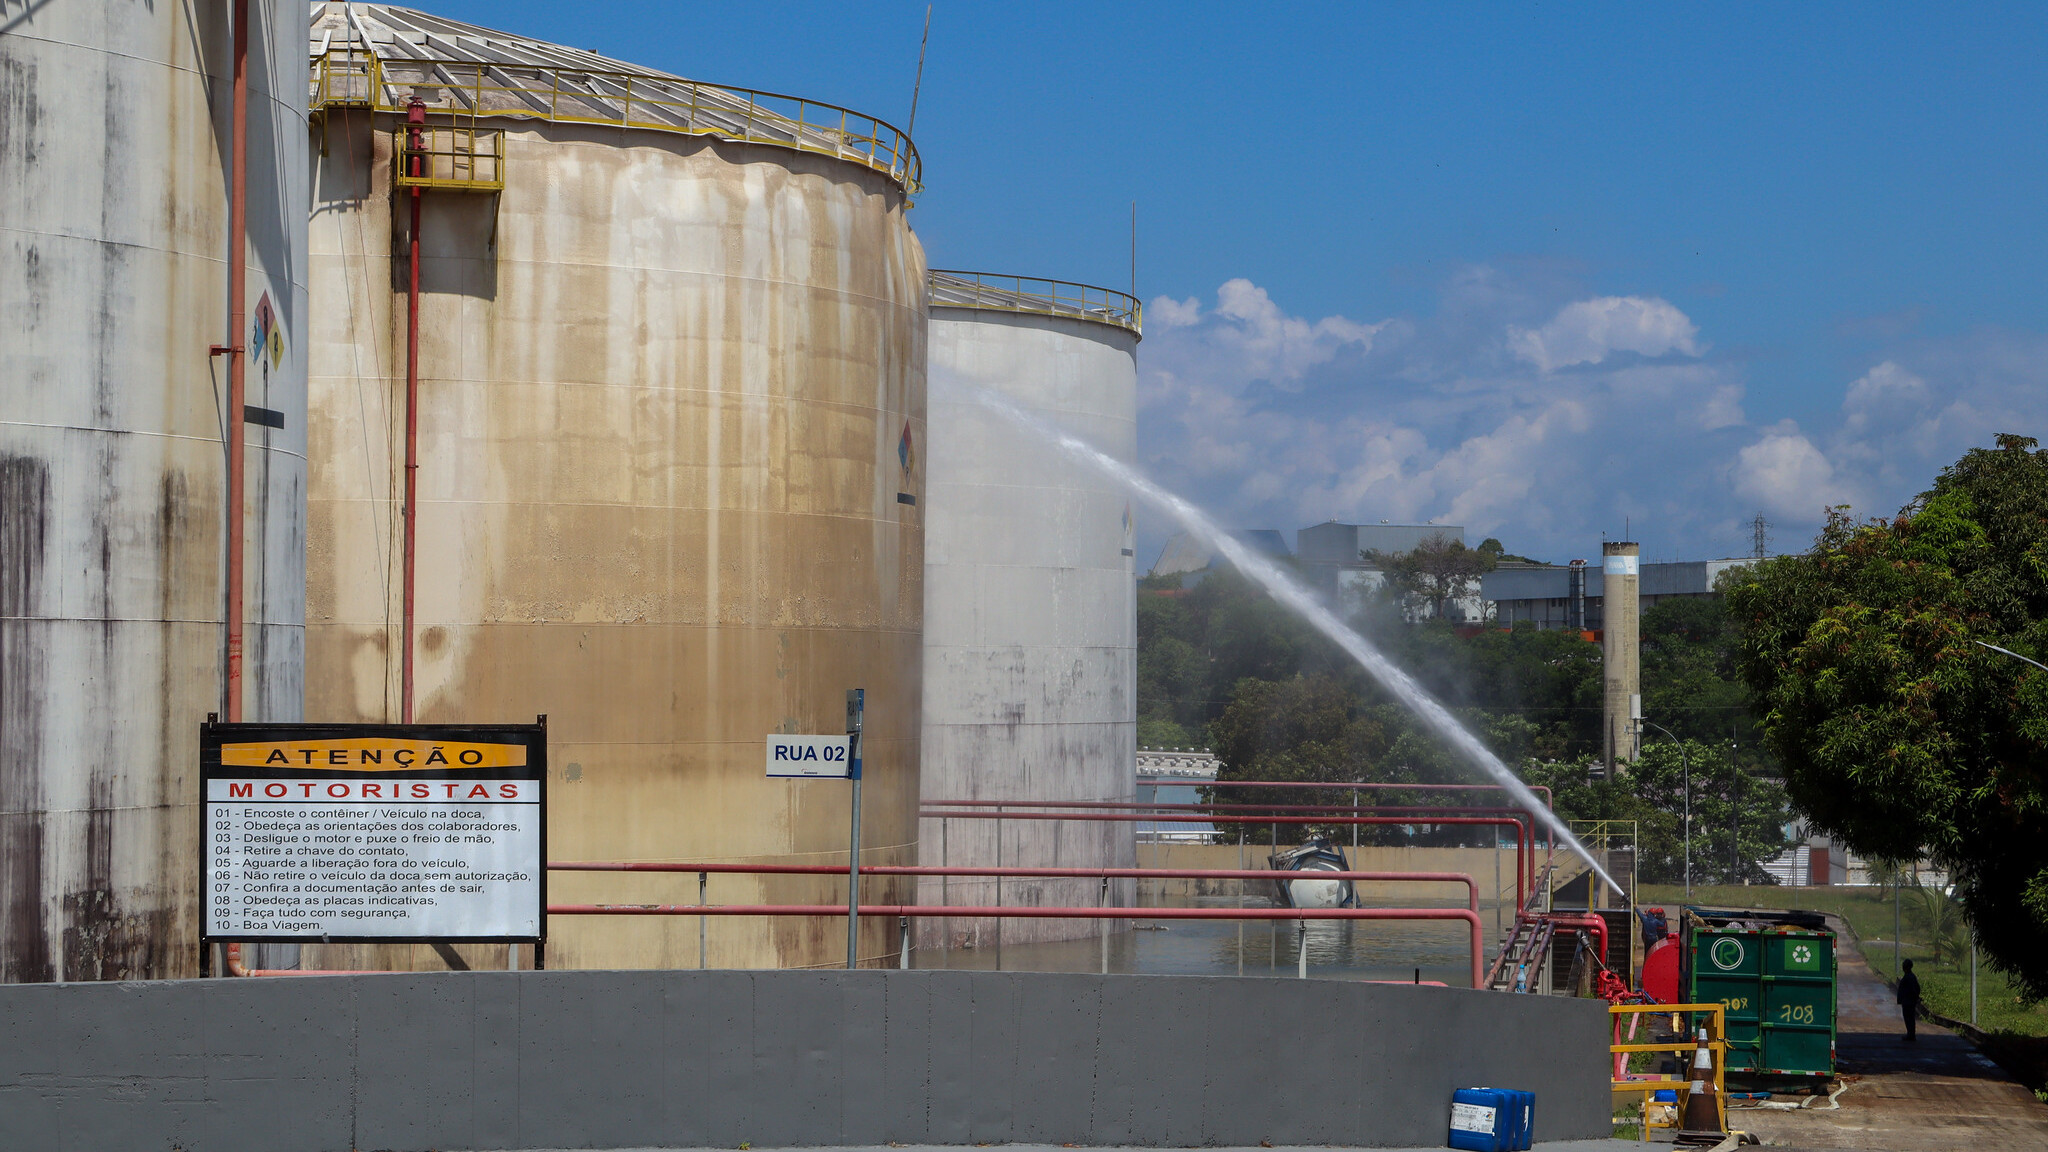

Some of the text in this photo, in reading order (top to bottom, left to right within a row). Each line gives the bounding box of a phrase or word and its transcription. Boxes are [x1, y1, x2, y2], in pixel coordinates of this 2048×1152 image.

[265, 746, 483, 768] ATENÇÃO
[775, 745, 845, 762] RUA 02
[229, 783, 519, 799] MOTORISTAS
[215, 808, 230, 818] 01
[244, 808, 295, 818] Encoste
[310, 808, 369, 818] contêiner
[381, 809, 427, 818] Veículo
[451, 809, 485, 820] doca,
[215, 821, 231, 830] 02
[244, 821, 301, 832] Obedeça
[324, 821, 397, 833] orientações
[401, 821, 424, 831] dos
[428, 821, 521, 833] colaboradores,
[215, 834, 231, 843] 03
[244, 834, 299, 845] Desligue
[315, 834, 351, 843] motor
[367, 836, 397, 845] puxe
[413, 834, 440, 843] freio
[445, 834, 460, 843] de
[464, 834, 495, 845] mão,
[215, 846, 230, 855] 04
[244, 846, 281, 855] Retire
[297, 846, 335, 855] chave
[339, 846, 354, 855] do
[358, 846, 408, 857] contato,
[215, 859, 231, 868] 05
[242, 859, 296, 870] Aguarde
[312, 859, 370, 870] liberação
[373, 859, 397, 868] fora
[402, 859, 417, 868] do
[421, 859, 470, 870] veículo,
[215, 871, 231, 880] 06
[243, 871, 270, 880] Não
[274, 871, 306, 880] retire
[321, 871, 366, 880] veículo
[370, 871, 386, 880] da
[390, 871, 420, 880] doca
[455, 871, 531, 883] autorização,
[215, 883, 230, 893] 07
[243, 883, 289, 893] Confira
[293, 885, 301, 893] a
[305, 883, 397, 895] documentação
[401, 883, 436, 893] antes
[440, 883, 456, 893] de
[460, 883, 485, 894] sair,
[215, 896, 230, 905] 08
[243, 896, 301, 907] Obedeça
[324, 896, 364, 907] placas
[368, 896, 438, 907] indicativas,
[215, 908, 230, 918] 09
[243, 908, 274, 920] Faça
[279, 908, 306, 918] tudo
[310, 910, 336, 918] com
[340, 910, 410, 920] segurança,
[216, 921, 230, 930] 10
[243, 921, 268, 930] Boa
[272, 921, 323, 932] Viagem.
[1780, 1005, 1814, 1024] 708
